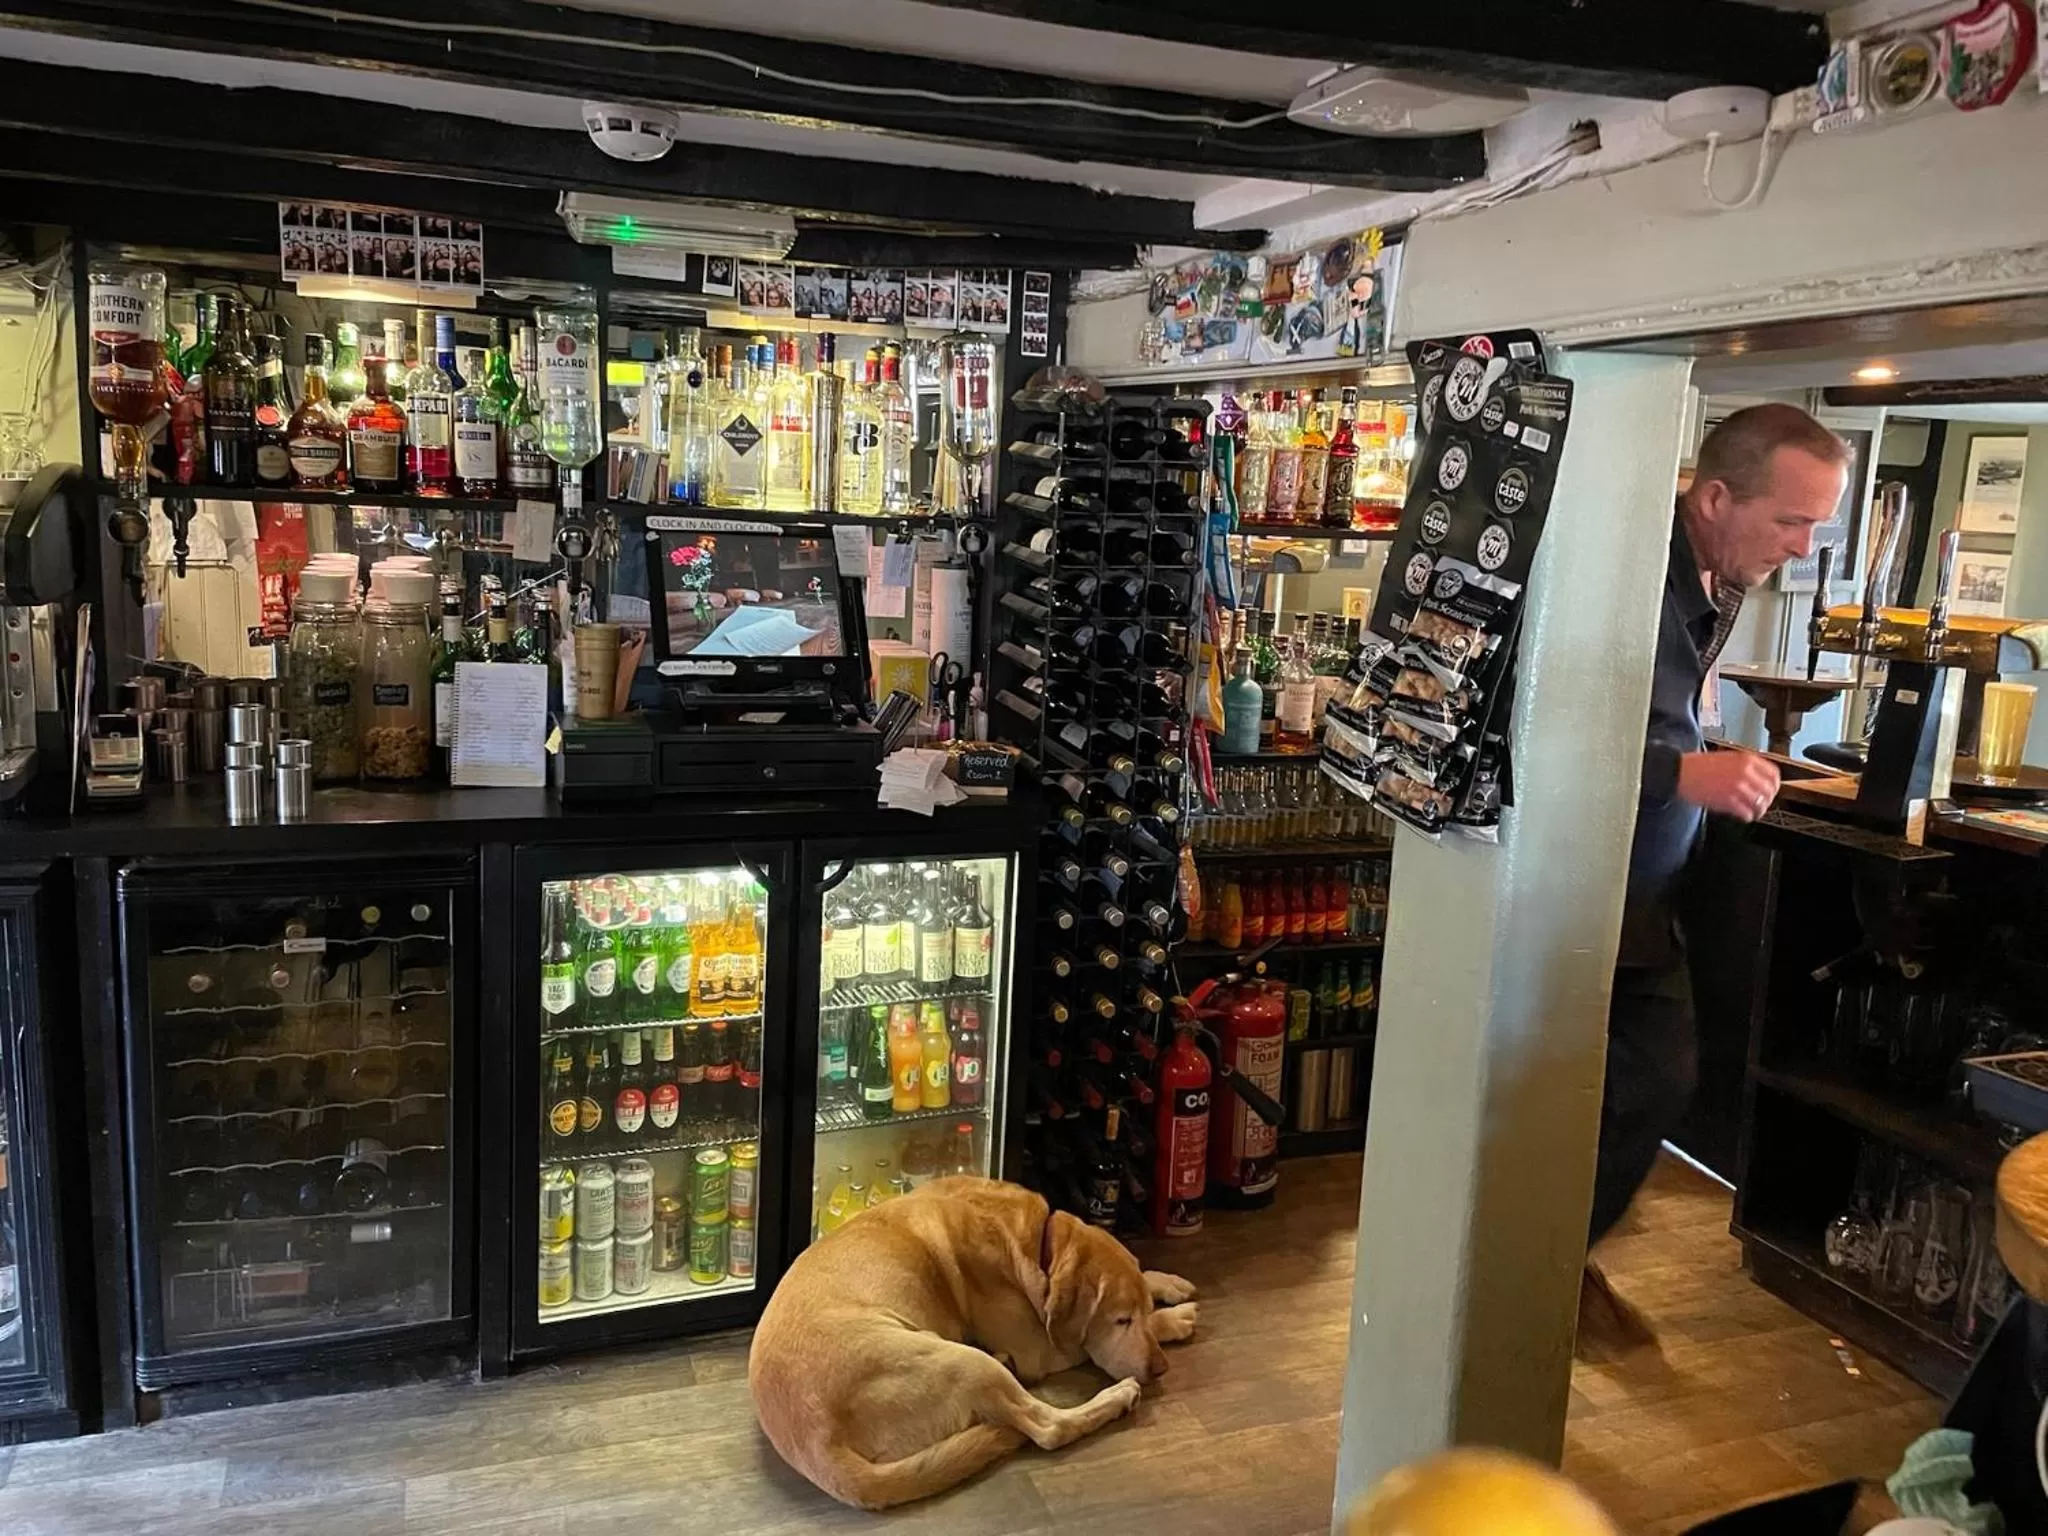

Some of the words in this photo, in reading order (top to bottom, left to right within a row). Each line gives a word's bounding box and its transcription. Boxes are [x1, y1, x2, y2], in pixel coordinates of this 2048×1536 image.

[93, 294, 144, 312] OUTHERN
[407, 399, 447, 412] AMPARI
[1498, 482, 1525, 502] taste
[650, 518, 685, 529] CLOCK
[686, 520, 696, 529] IN
[701, 521, 720, 530] AND
[1424, 515, 1448, 534] taste
[962, 753, 1009, 768] Reserved
[1251, 1049, 1280, 1065] FOAM
[1185, 1091, 1209, 1109] CO
